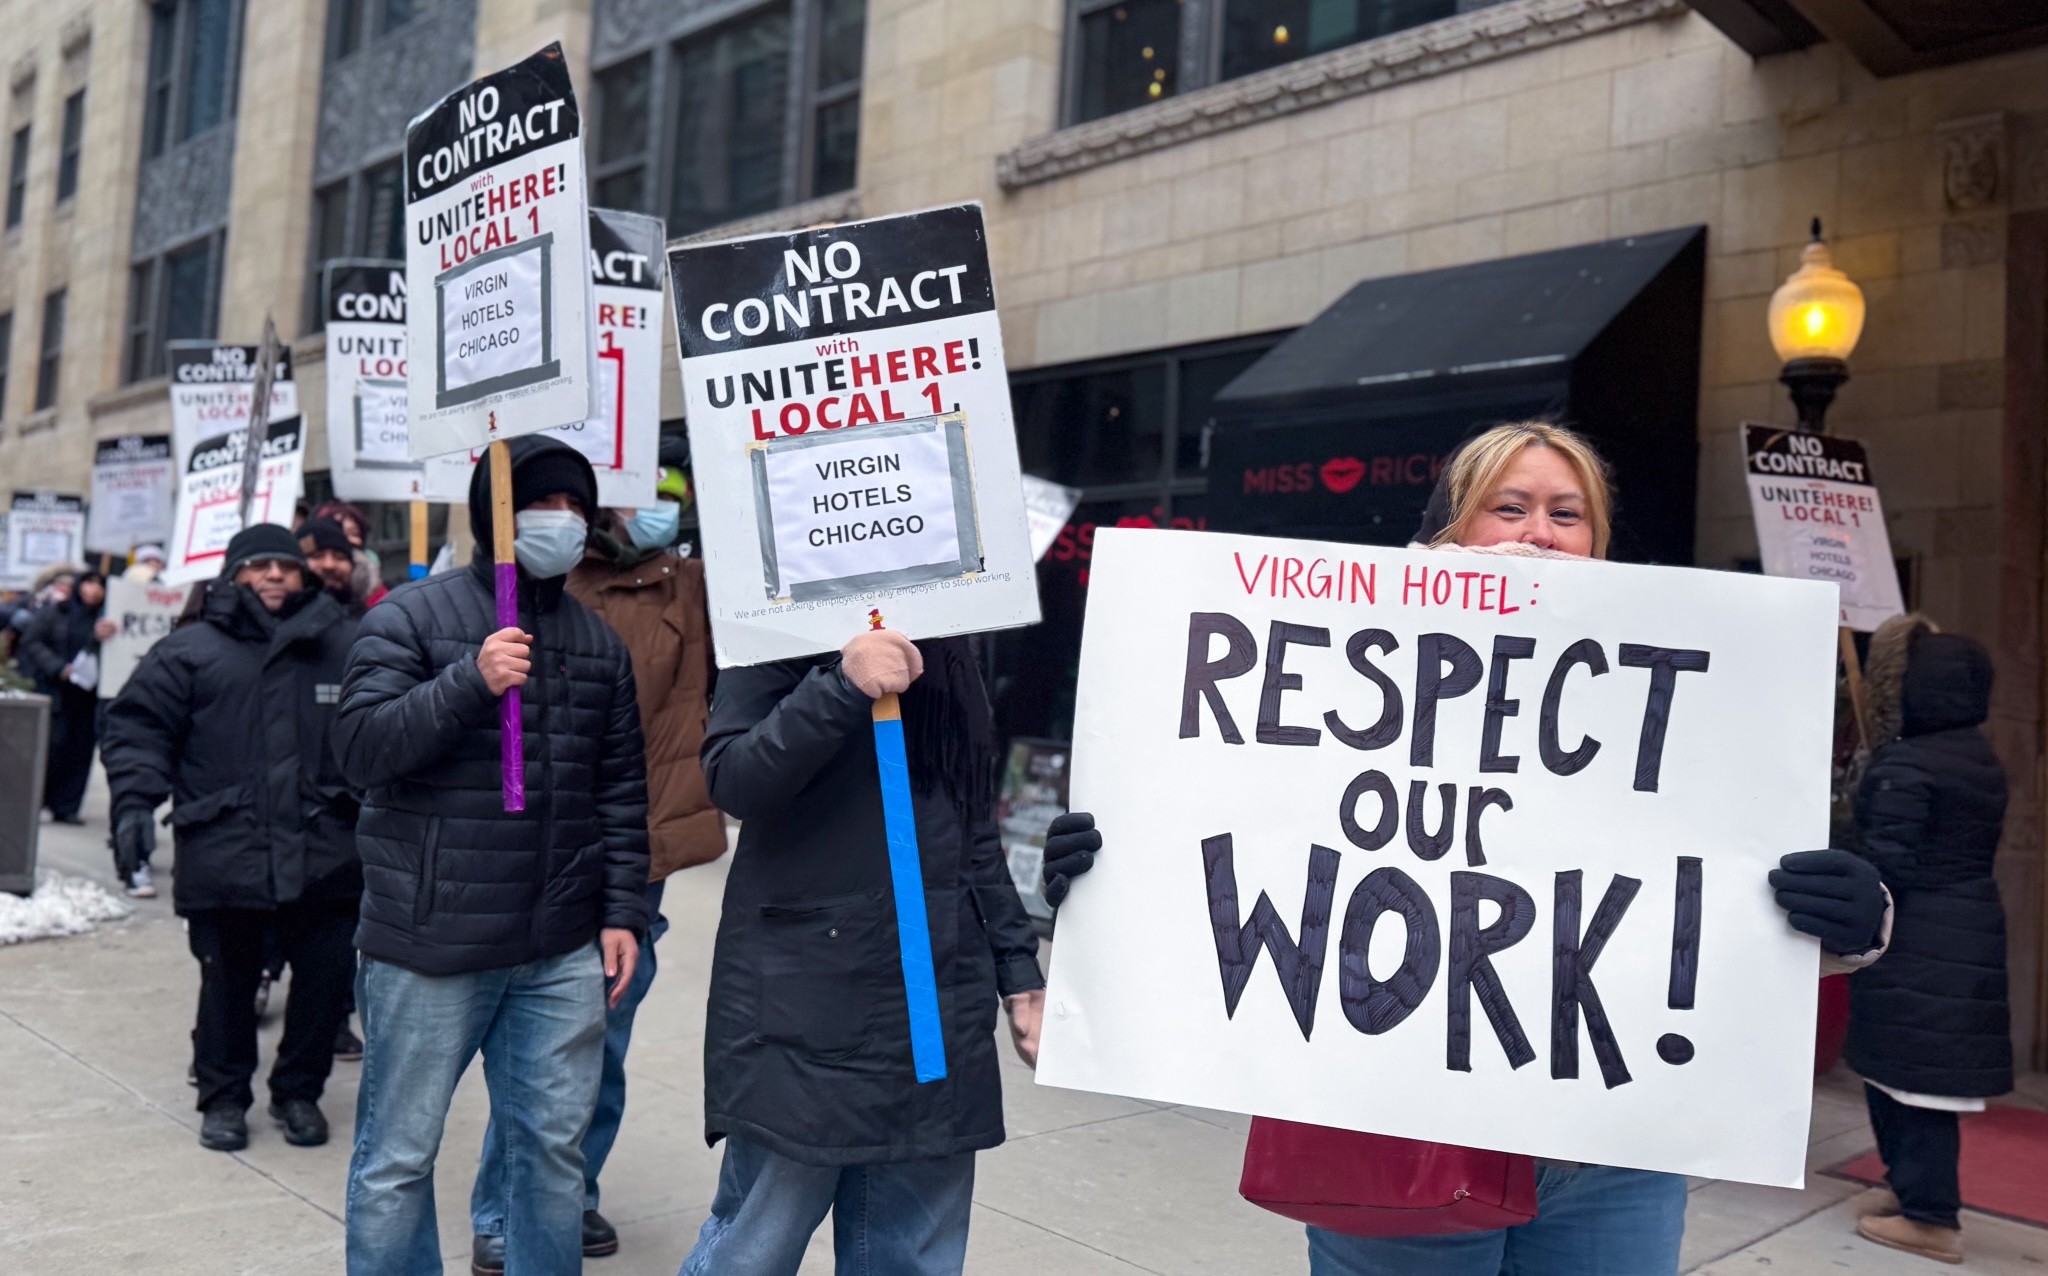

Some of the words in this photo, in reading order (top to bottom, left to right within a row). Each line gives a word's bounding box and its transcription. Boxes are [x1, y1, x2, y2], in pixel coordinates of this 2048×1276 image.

[459, 86, 499, 132] NO
[417, 99, 565, 188] CONTRACT
[471, 172, 494, 193] with
[418, 164, 565, 245] UNITEHERE!
[441, 220, 517, 270] LOCAL
[528, 206, 540, 235] 1
[784, 240, 860, 287] NO
[464, 272, 508, 301] VIRGIN
[701, 264, 968, 341] CONTRACT
[337, 293, 406, 321] CON
[461, 300, 514, 330] HOTELS
[459, 327, 519, 359] CHICAGO
[815, 337, 859, 357] with
[706, 338, 982, 408] UNITEHERE!
[751, 388, 906, 440] LOCAL
[921, 382, 943, 415] 1
[1788, 435, 1823, 456] NO
[815, 453, 901, 480] VIRGIN
[1244, 462, 1313, 495] MISS
[1755, 451, 1864, 482] CONTRACT
[812, 483, 912, 514] HOTELS
[1761, 485, 1874, 513] UNITEHERE!
[808, 515, 924, 548] CHICAGO
[1782, 505, 1845, 526] LOCAL
[1851, 512, 1860, 528] 1
[734, 610, 749, 620] We
[751, 608, 766, 617] are
[768, 605, 783, 614] not
[786, 600, 814, 612] asking
[816, 593, 865, 608] employees
[878, 588, 894, 599] any
[897, 582, 938, 596] employer
[941, 580, 950, 589] to
[952, 577, 972, 588] stop
[1234, 552, 1376, 605] VIRGIN
[1402, 564, 1540, 614] HOTEL:
[1179, 612, 1711, 792] RESPECT
[1201, 833, 1703, 1090] WORK!
